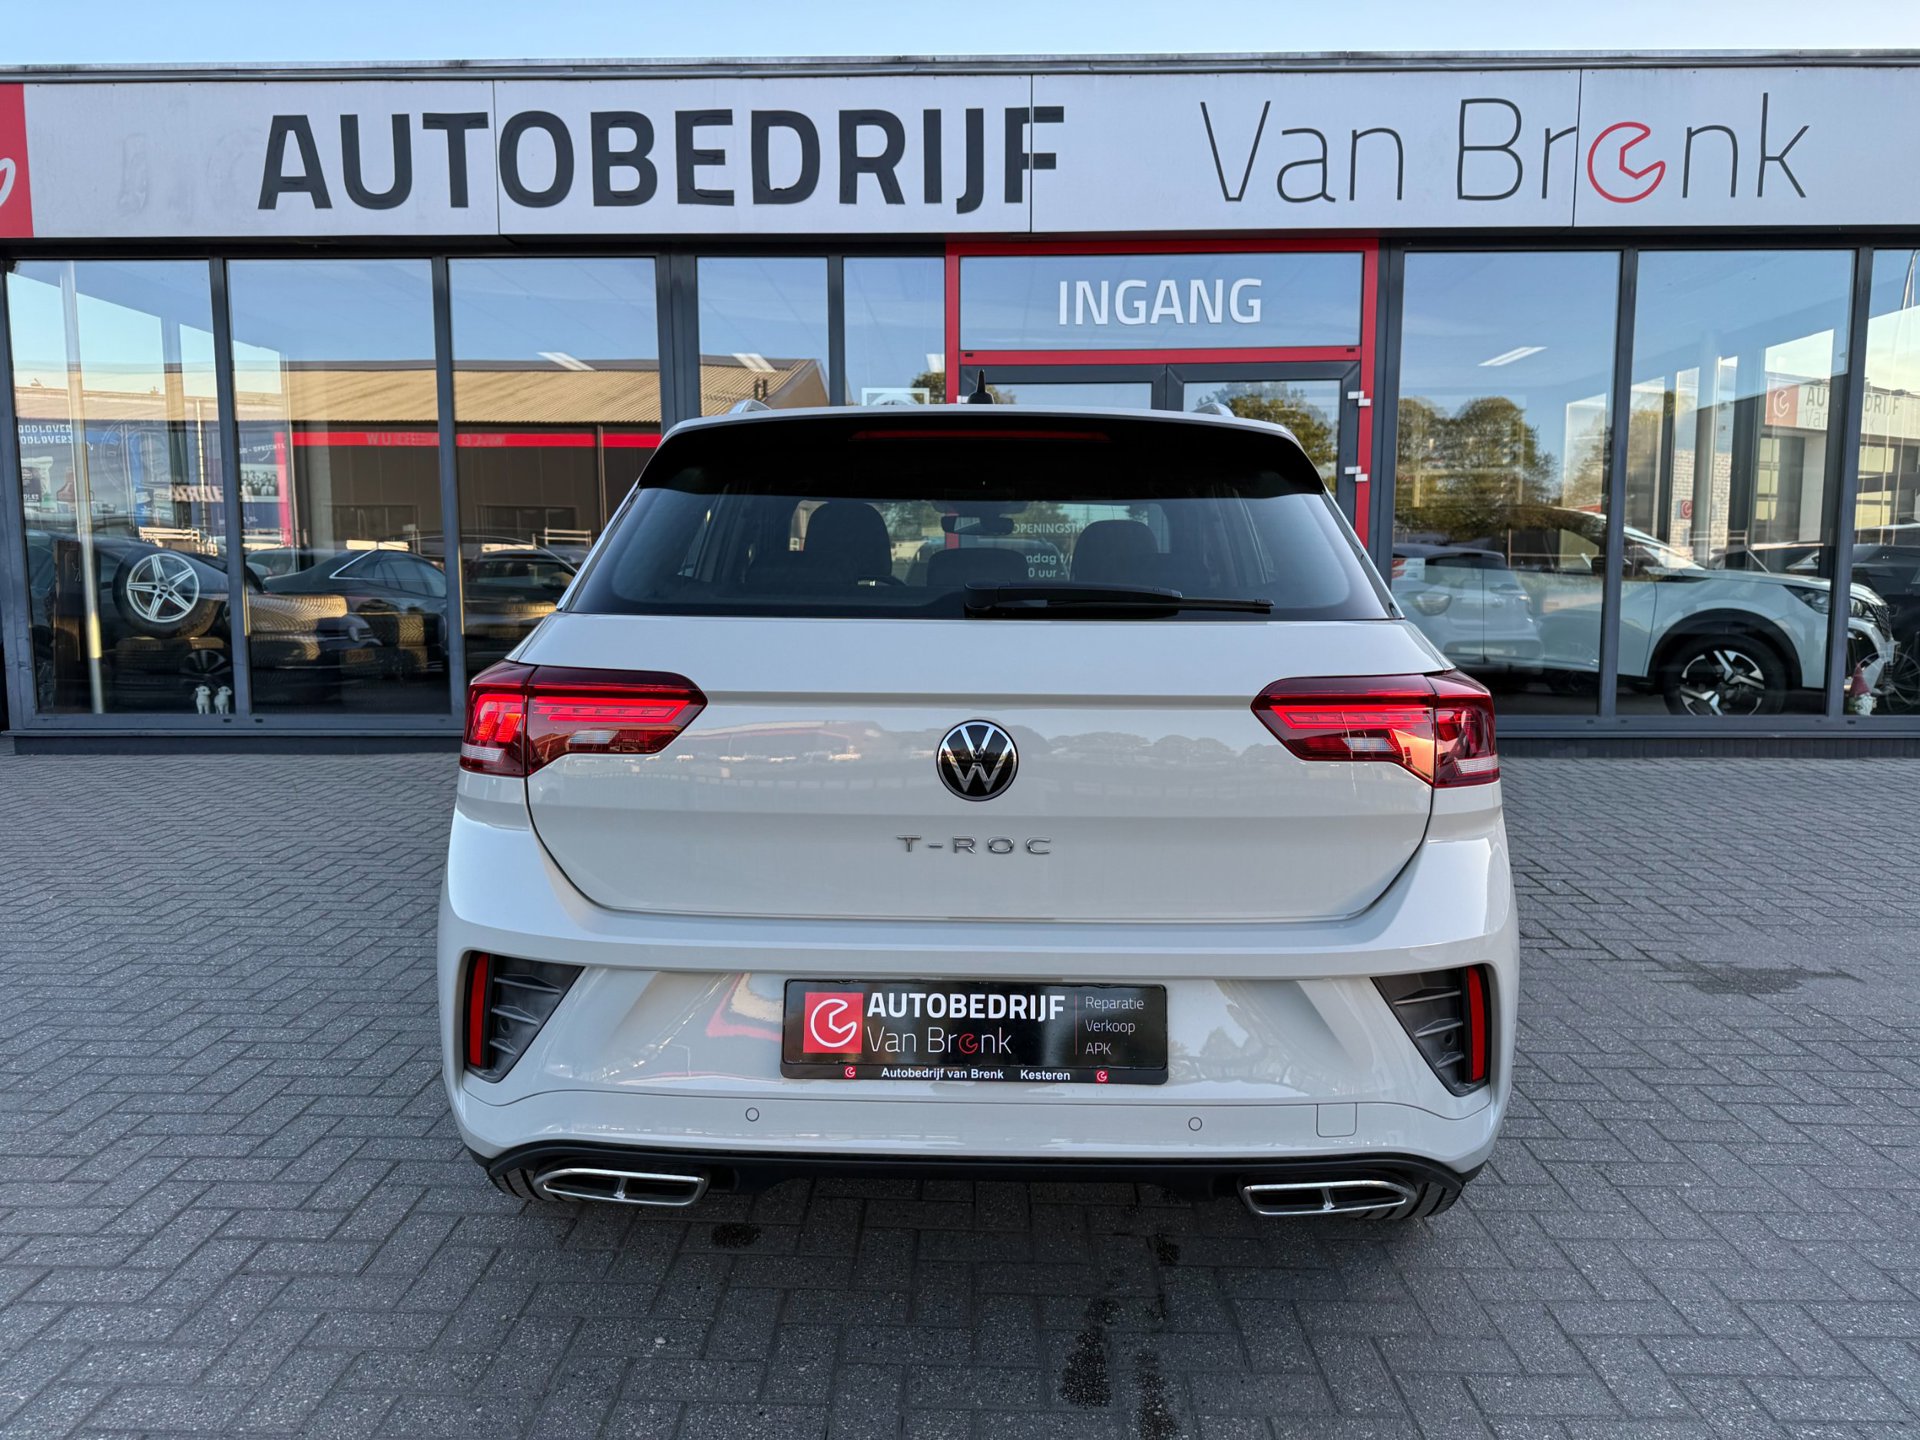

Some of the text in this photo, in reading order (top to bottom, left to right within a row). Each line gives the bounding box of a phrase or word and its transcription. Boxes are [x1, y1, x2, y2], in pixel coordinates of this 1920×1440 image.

[258, 105, 1065, 215] AUTOBEDRIJF
[1199, 100, 1403, 203] Van
[1057, 278, 1263, 327] INGANG
[1026, 552, 1057, 566] ndag
[1038, 569, 1057, 578] uur
[896, 834, 1051, 855] T-ROC
[866, 992, 1066, 1022] AUTOBEDRIJF
[1084, 996, 1145, 1012] Reparatie
[1084, 1019, 1136, 1035] Verkoop
[867, 1026, 918, 1053] Van
[1084, 1042, 1112, 1056] APK
[881, 1067, 1071, 1081] Autobedrijf van Brenk Kesteren
